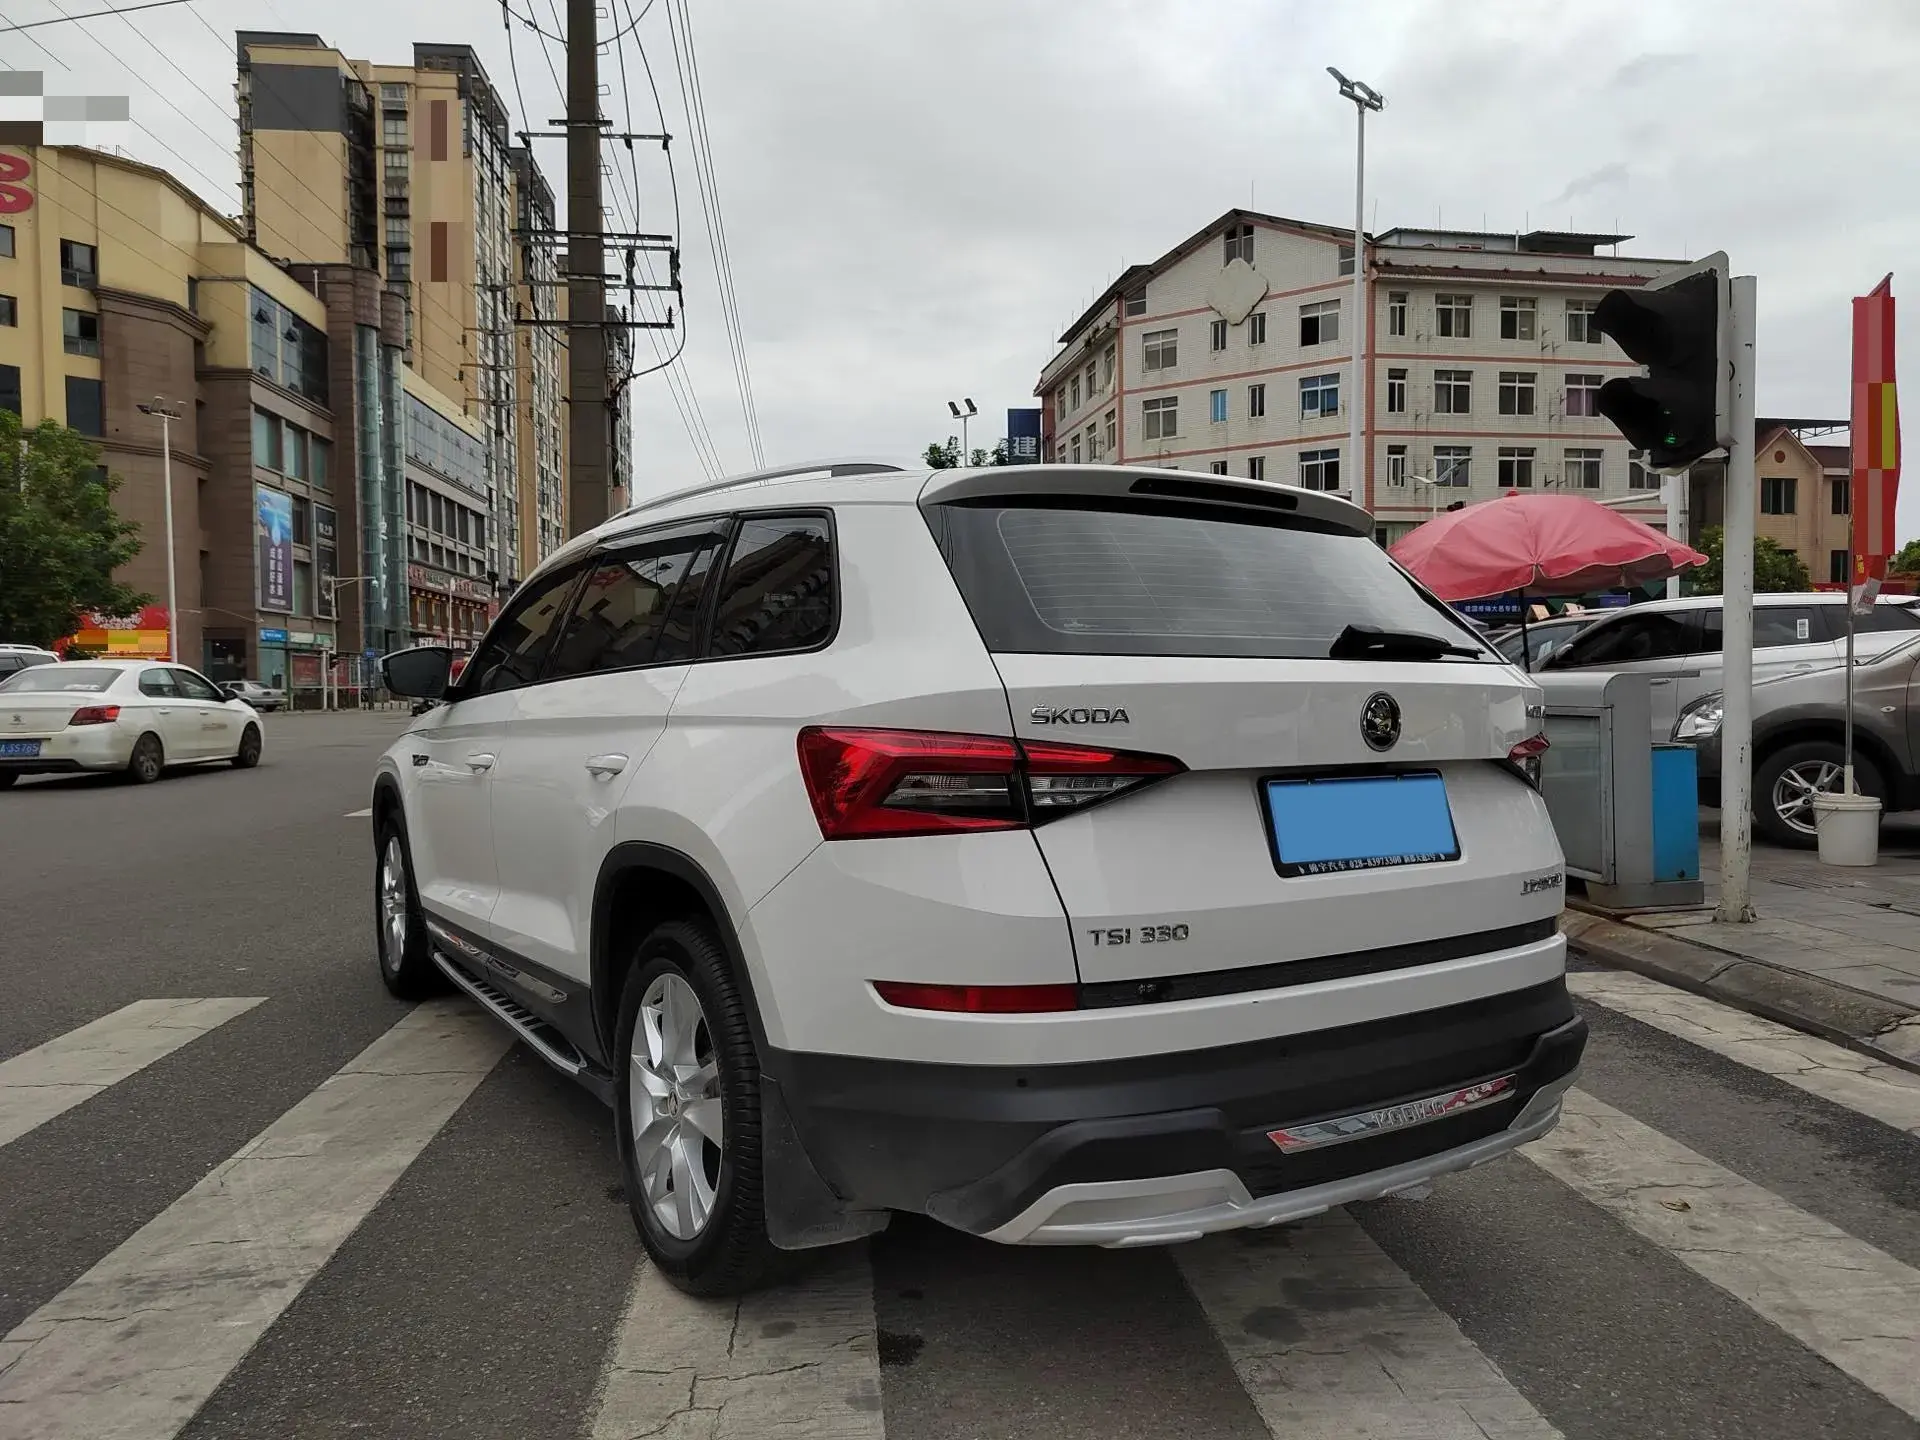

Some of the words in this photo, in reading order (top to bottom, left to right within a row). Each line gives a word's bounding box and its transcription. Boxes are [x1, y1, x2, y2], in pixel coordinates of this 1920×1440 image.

[1031, 703, 1130, 725] ŠKODA
[1087, 928, 1131, 946] TSI
[1140, 924, 1189, 944] 330
